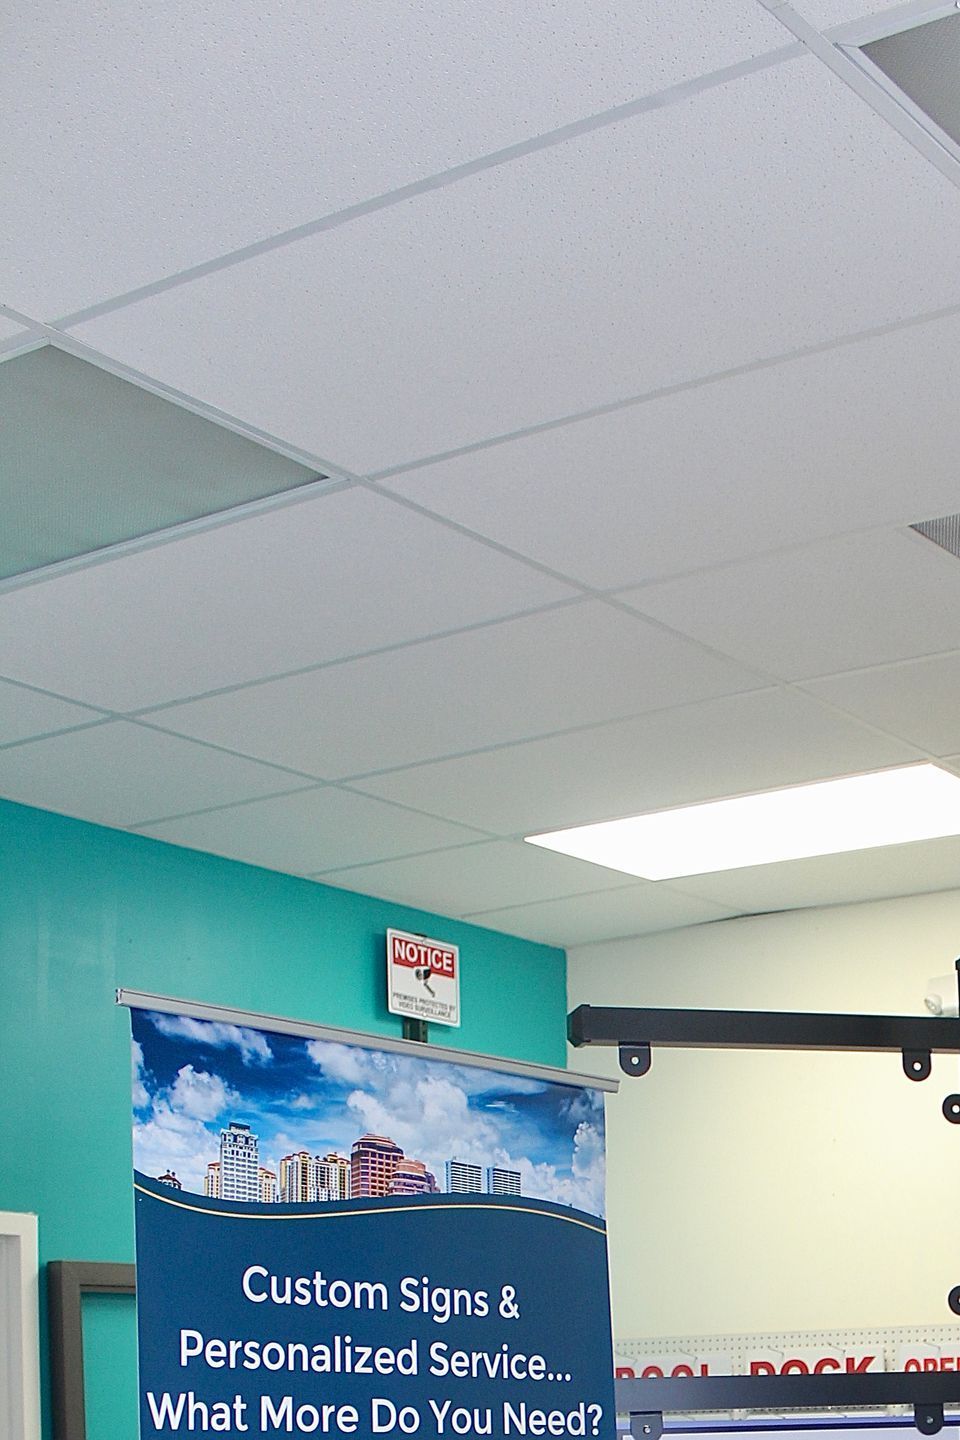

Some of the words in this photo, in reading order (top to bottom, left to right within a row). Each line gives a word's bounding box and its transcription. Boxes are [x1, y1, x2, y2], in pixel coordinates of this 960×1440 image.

[395, 940, 452, 971] NOTICE
[242, 1265, 388, 1310] Custom
[399, 1277, 489, 1323] Signs
[499, 1285, 520, 1319] &
[179, 1329, 418, 1376] Personalized
[429, 1343, 572, 1382] Service...
[147, 1392, 248, 1432] What
[260, 1396, 358, 1433] More
[372, 1399, 421, 1434] Do
[429, 1400, 492, 1435] You
[503, 1403, 602, 1437] Need?
